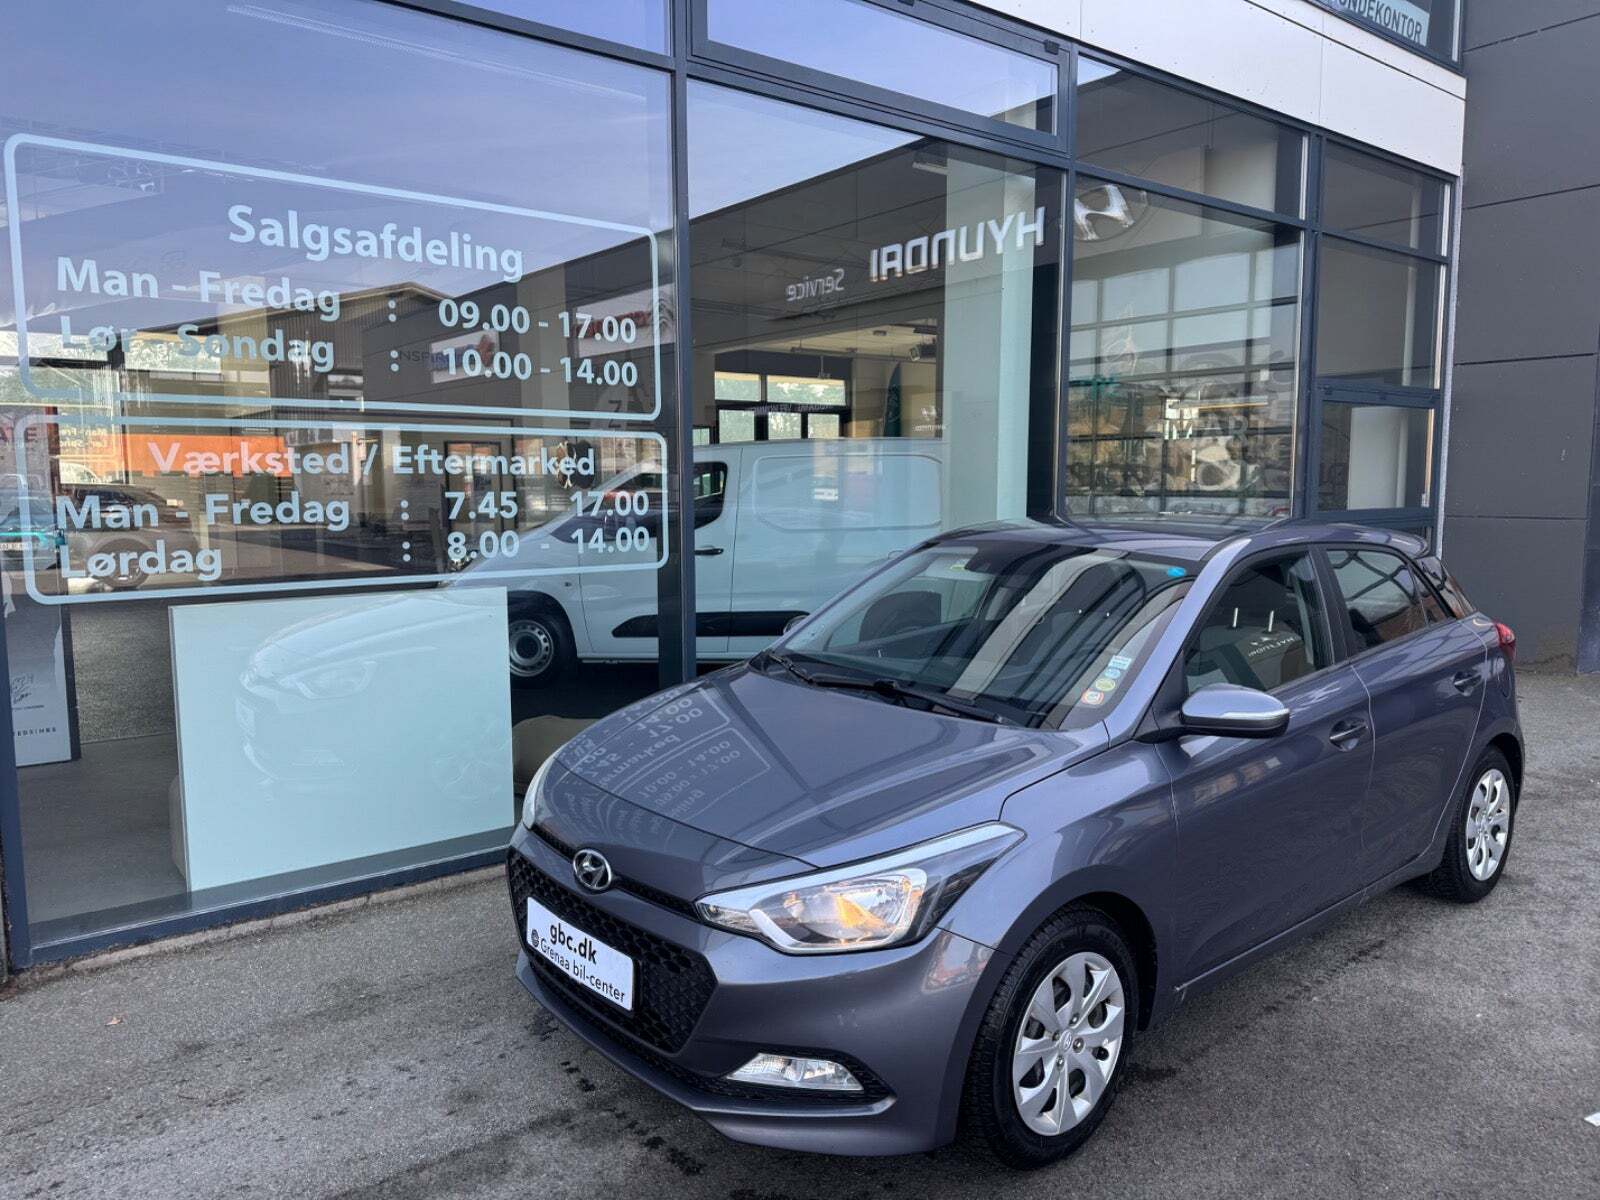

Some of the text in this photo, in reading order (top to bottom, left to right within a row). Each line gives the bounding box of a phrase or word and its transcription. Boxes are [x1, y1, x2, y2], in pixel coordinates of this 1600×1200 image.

[227, 204, 524, 283] Salgsafdeling
[57, 256, 159, 299] Man
[199, 270, 341, 323] Fredag
[438, 299, 531, 335] 09.00
[558, 311, 637, 344] 17.00
[60, 316, 138, 353] Lør
[442, 347, 533, 381] 10.00
[559, 356, 638, 388] 14.00
[148, 441, 349, 478] Værksted
[392, 444, 596, 476] Eftermarked
[55, 495, 159, 530] Man
[204, 491, 350, 532] Fredag
[444, 491, 519, 520] 7.45
[569, 490, 650, 518] 17.00
[59, 539, 223, 582] Lørdag
[447, 530, 520, 561] 8.00
[570, 526, 651, 554] 14.00
[540, 938, 625, 1004] Grenaa bil-center
[549, 923, 597, 965] gbc.dk
